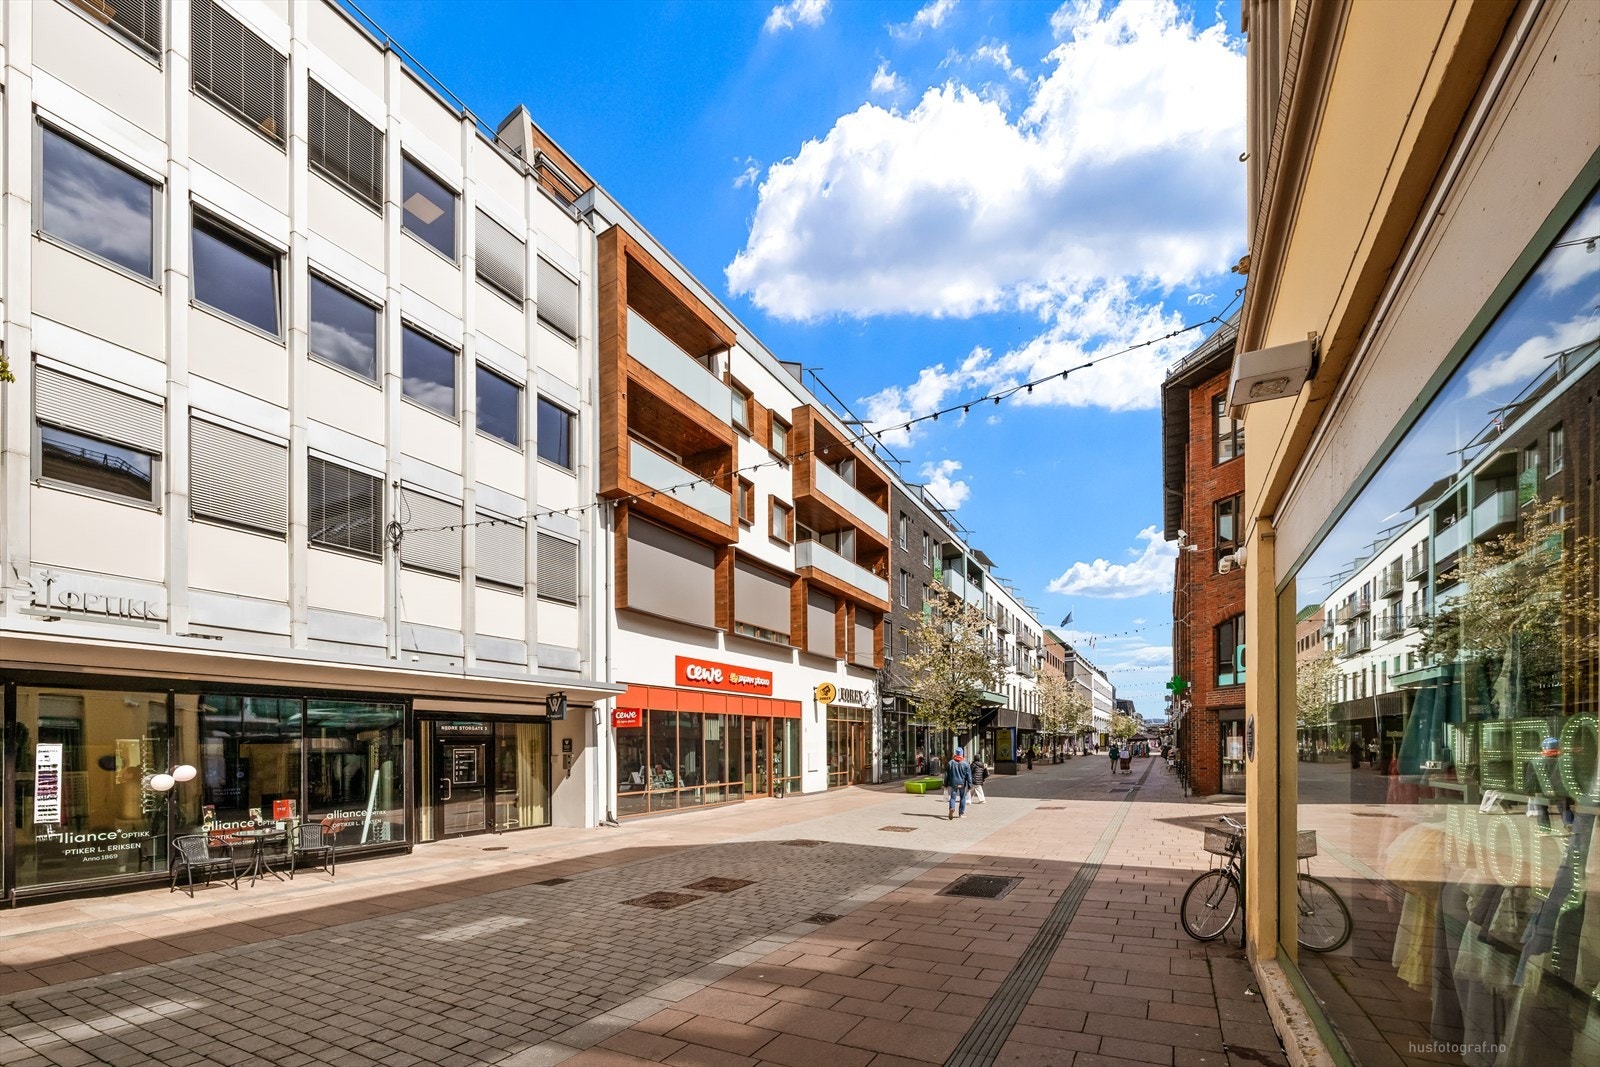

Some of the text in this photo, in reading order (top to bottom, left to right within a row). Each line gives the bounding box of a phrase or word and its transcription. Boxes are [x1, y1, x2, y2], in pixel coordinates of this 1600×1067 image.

[58, 590, 160, 617] OPTIKK
[326, 809, 368, 820] alliance
[59, 830, 151, 844] lliance OPTIKK
[63, 847, 96, 856] PTIKER
[107, 842, 142, 852] ERIKSEN
